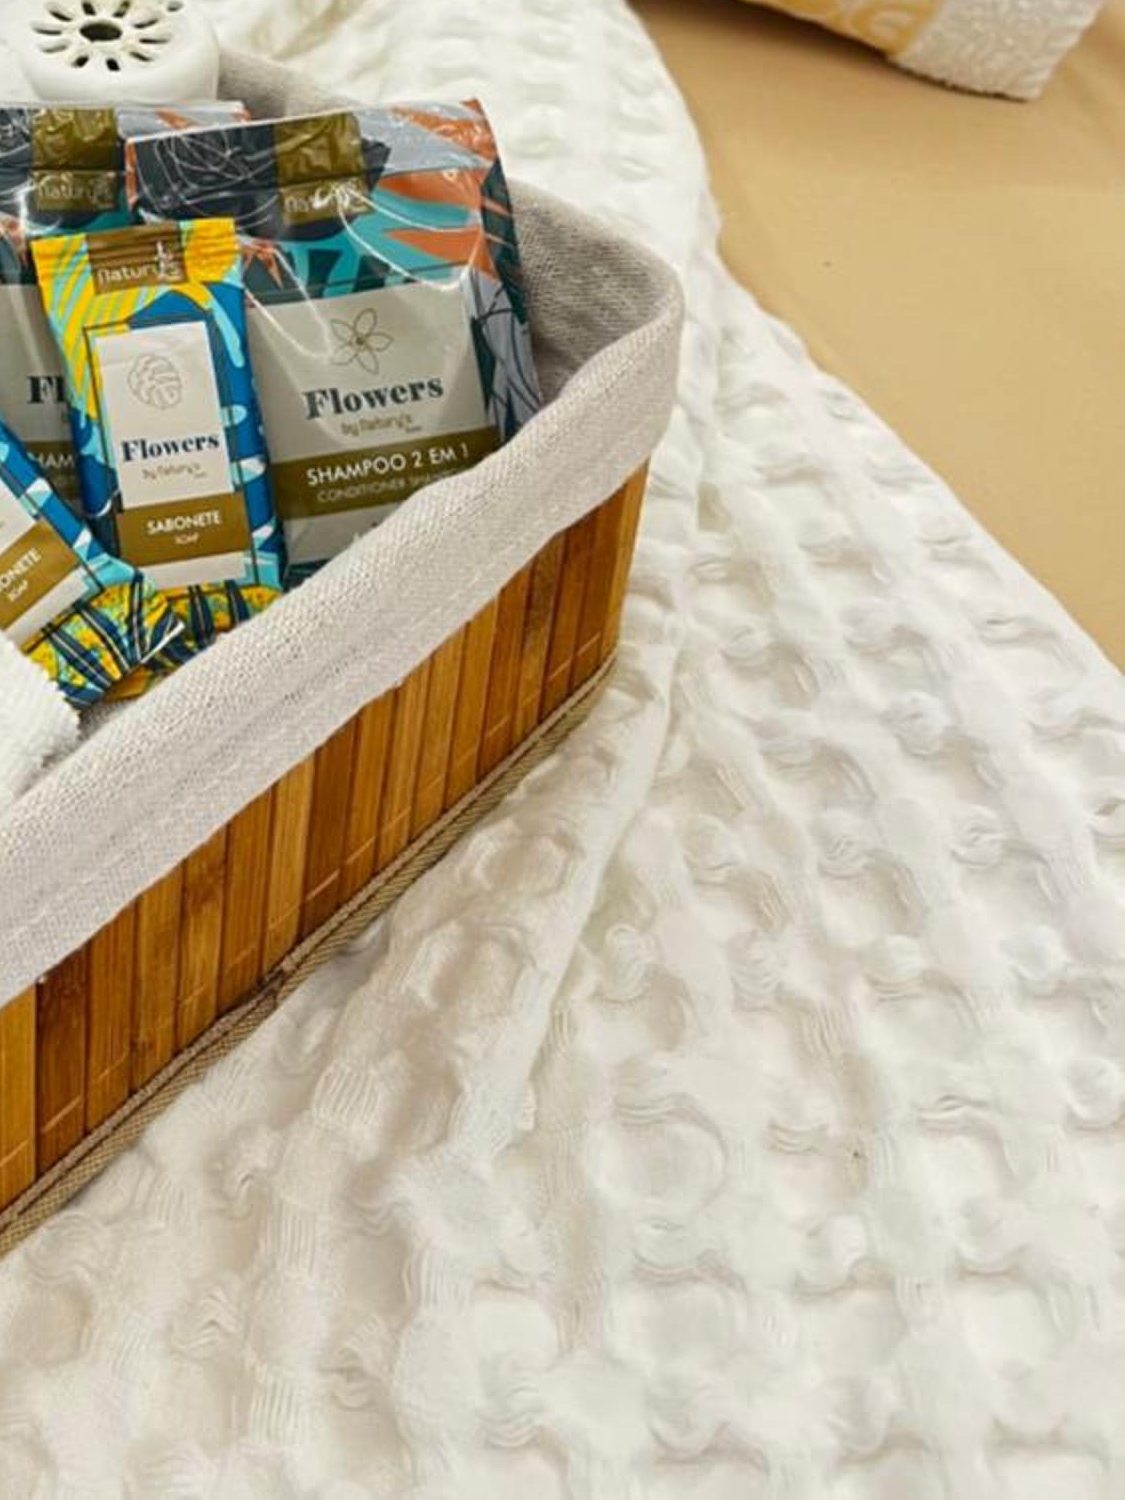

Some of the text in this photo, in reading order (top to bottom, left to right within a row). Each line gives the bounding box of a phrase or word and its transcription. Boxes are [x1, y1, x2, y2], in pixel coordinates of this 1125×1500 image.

[302, 377, 444, 420] Flowers
[122, 434, 220, 462] Flowers
[307, 453, 406, 486] SHAMPOO
[411, 452, 423, 468] 2
[429, 446, 457, 465] EM
[462, 443, 469, 458] 1
[146, 510, 221, 535] SABONETE
